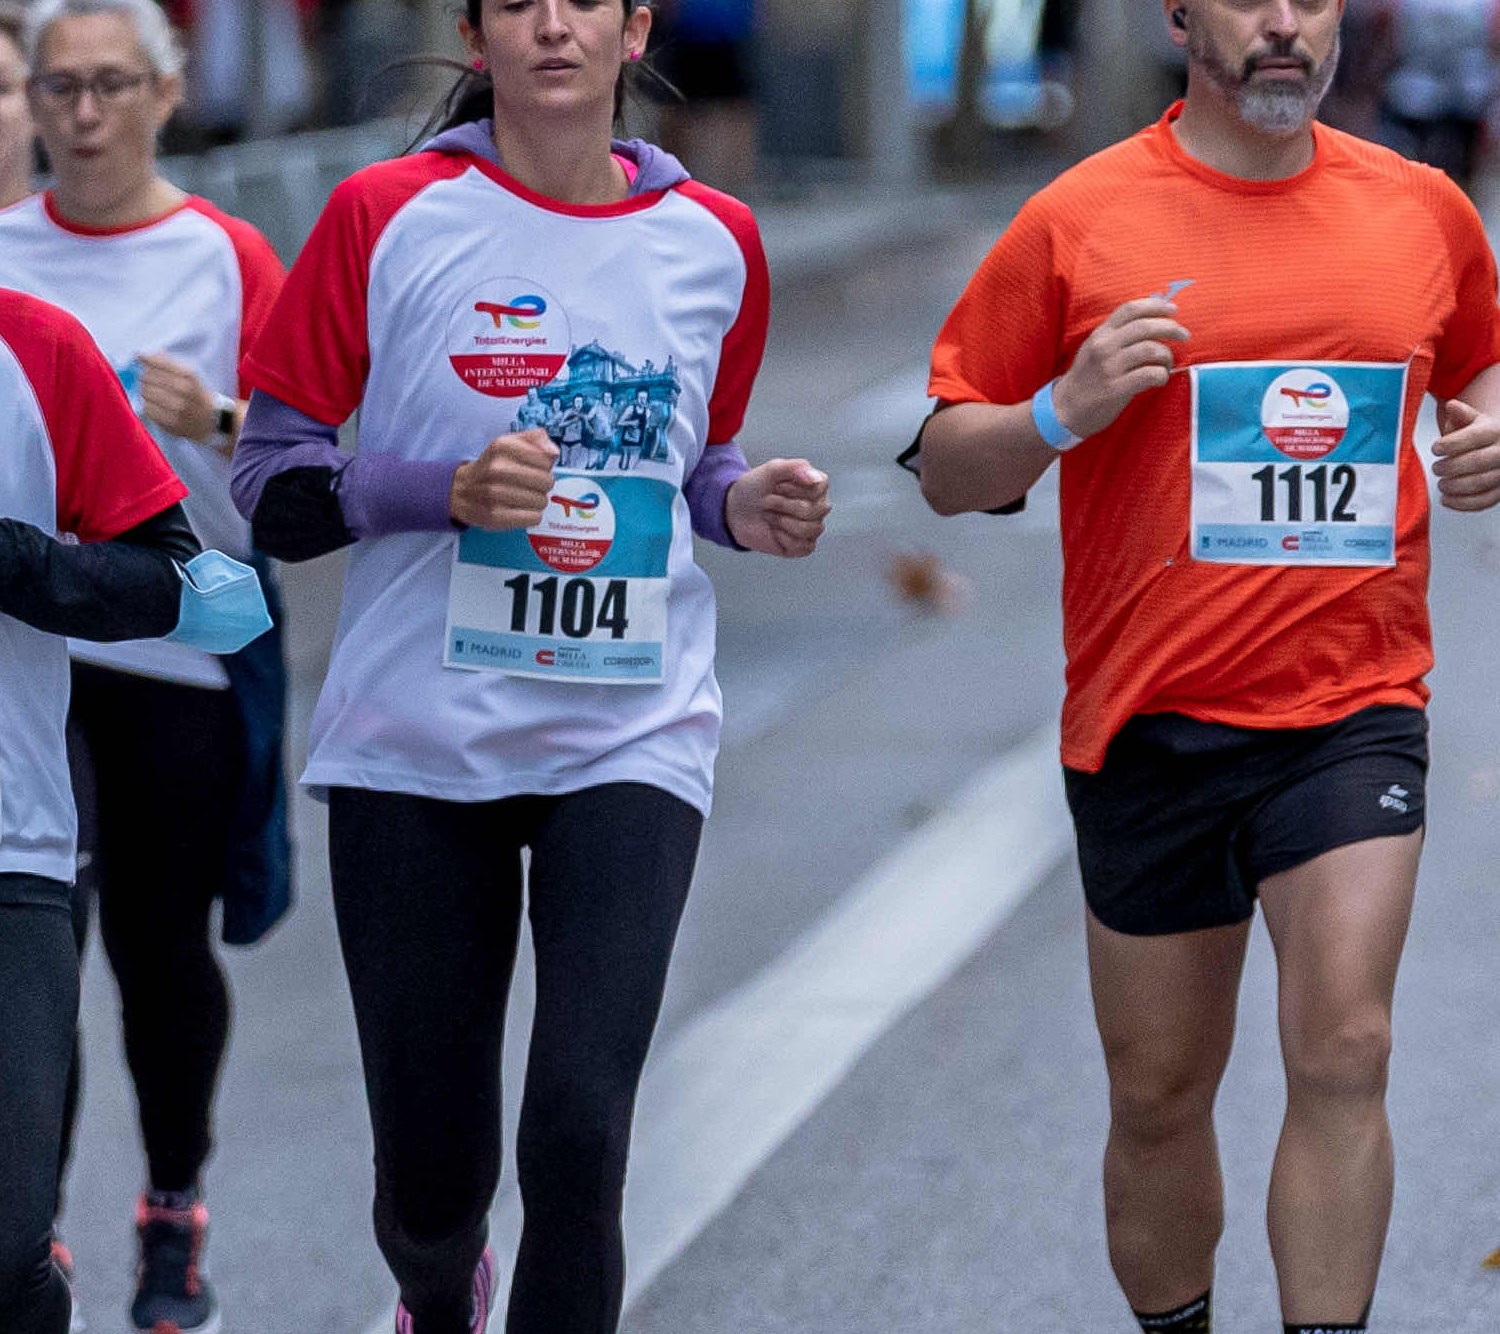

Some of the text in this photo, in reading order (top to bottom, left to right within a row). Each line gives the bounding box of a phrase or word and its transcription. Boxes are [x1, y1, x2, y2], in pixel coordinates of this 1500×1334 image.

[1252, 464, 1357, 522] 1112
[504, 573, 629, 640] 1104
[469, 642, 522, 659] MADRID
